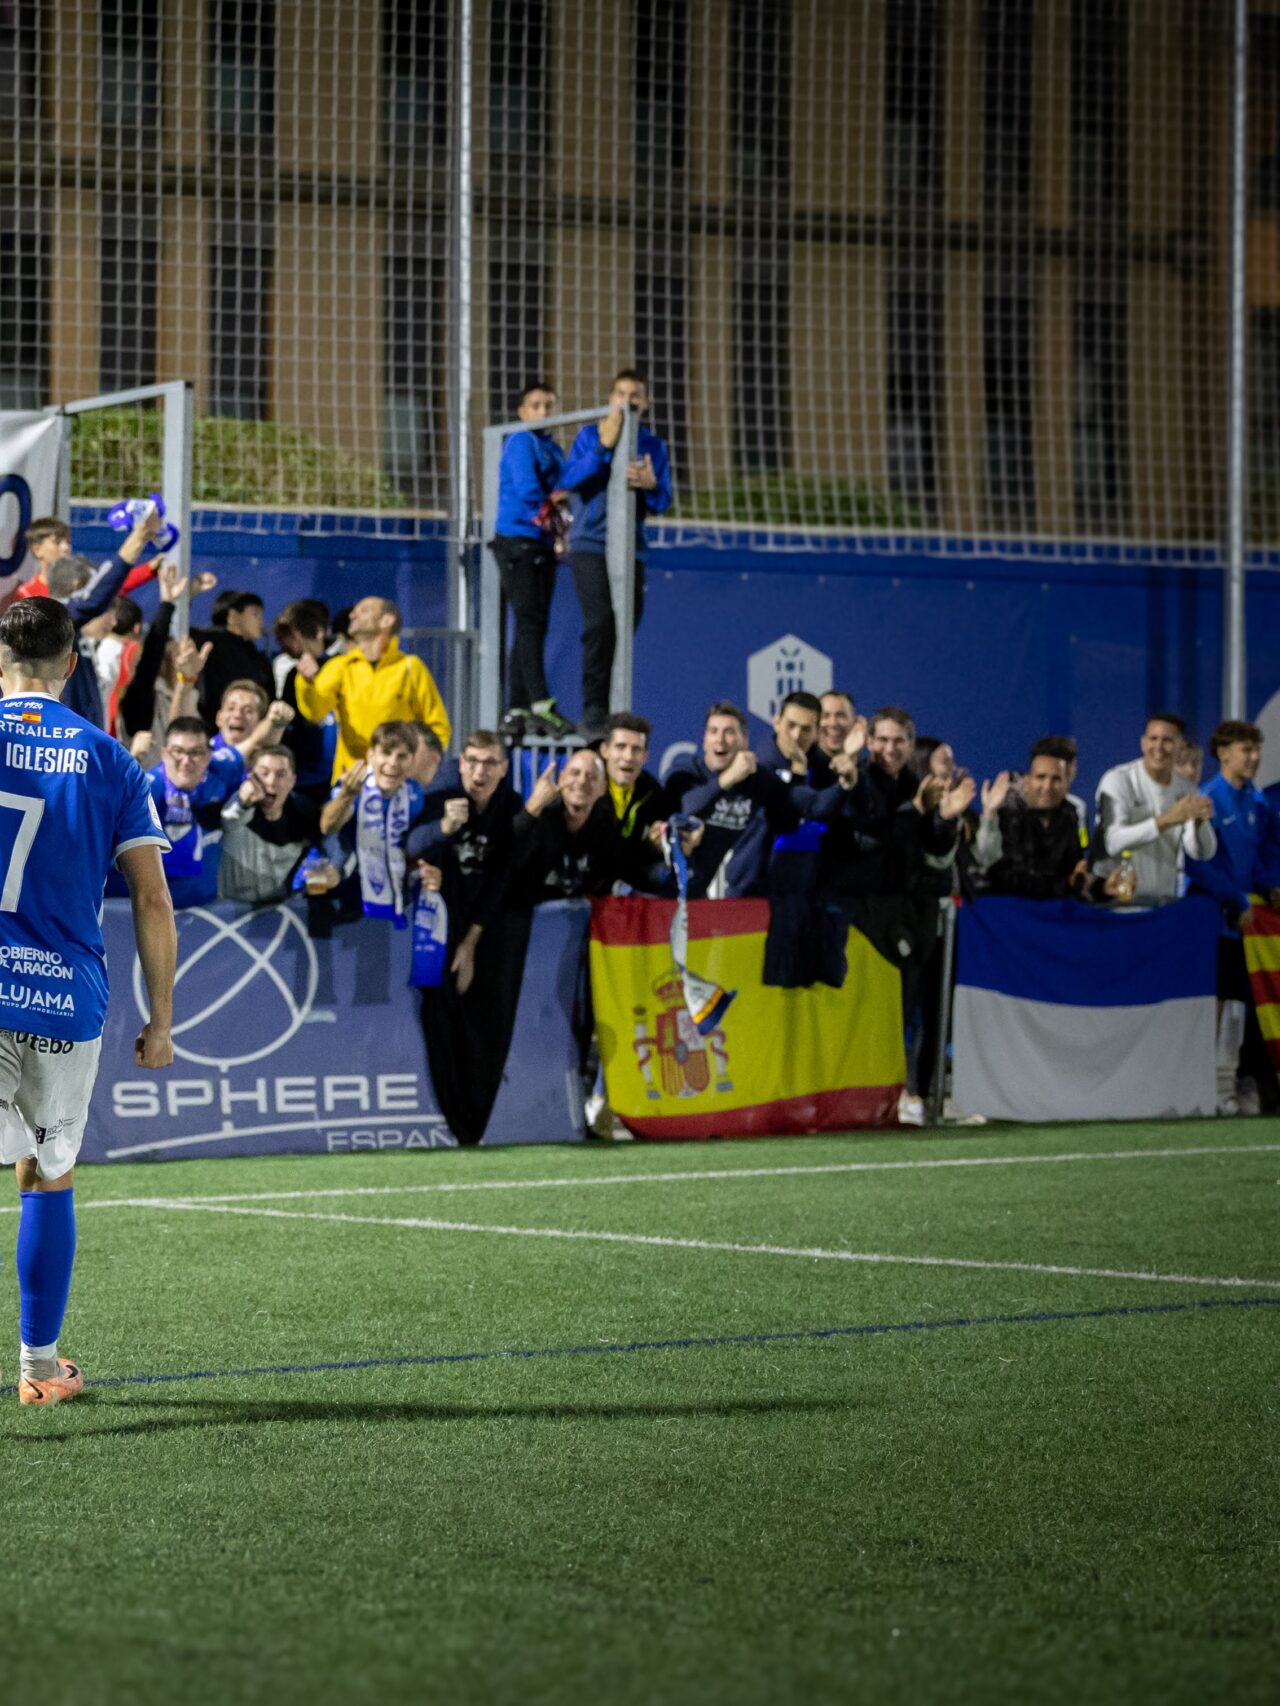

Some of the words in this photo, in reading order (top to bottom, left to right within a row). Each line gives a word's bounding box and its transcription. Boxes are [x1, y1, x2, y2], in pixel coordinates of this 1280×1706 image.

[6, 742, 89, 774] IGLESIAS
[12, 961, 74, 980] ARAGON
[112, 1072, 418, 1117] SPHERE
[326, 1124, 461, 1152] ESPAÑ
